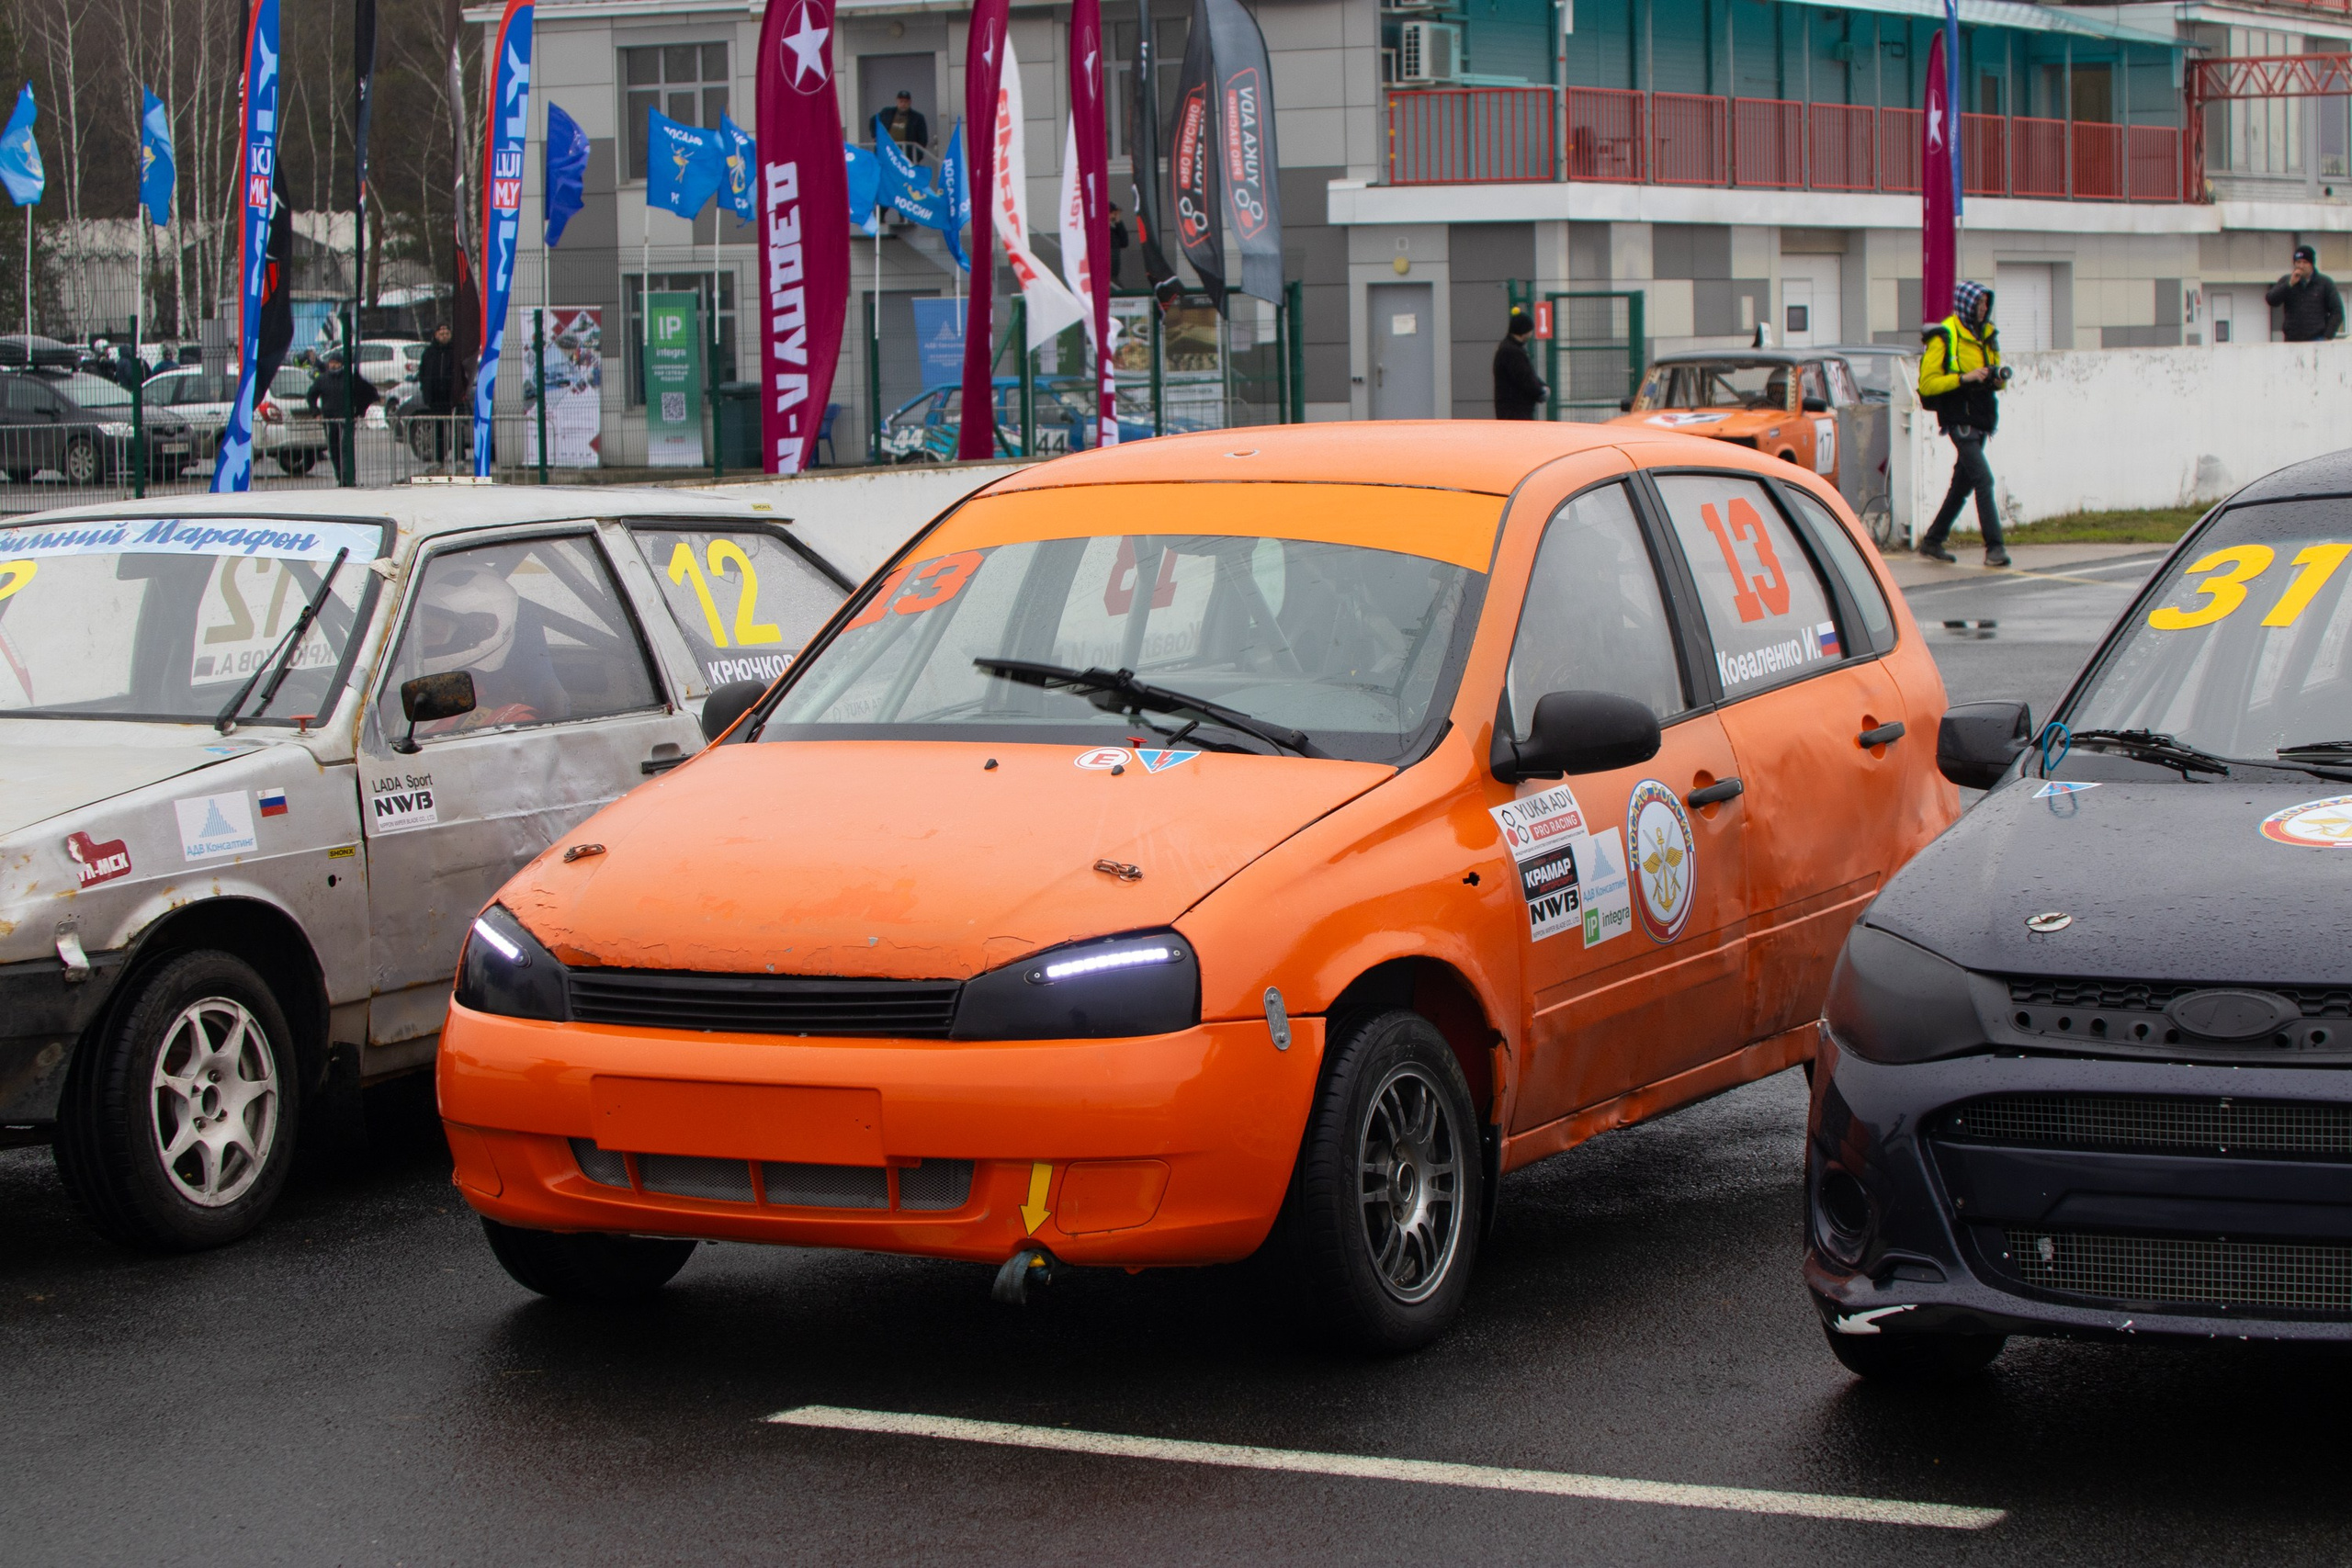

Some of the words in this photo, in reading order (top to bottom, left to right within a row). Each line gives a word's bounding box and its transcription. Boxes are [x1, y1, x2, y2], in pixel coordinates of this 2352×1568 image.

[658, 315, 682, 340] IP
[1539, 308, 1548, 334] 1
[1818, 432, 1833, 461] 17
[132, 519, 320, 555] Марафон
[1701, 497, 1790, 623] 13
[667, 538, 783, 648] 12
[840, 550, 985, 635] 13
[2147, 543, 2352, 631] 31
[1715, 637, 1803, 687] Коваленко
[1801, 626, 1823, 661] И.
[1089, 753, 1120, 765] E
[372, 776, 403, 793] LADA
[405, 773, 434, 790] Sport
[373, 790, 434, 818] NWB
[1513, 797, 1553, 820] YUKA
[1548, 788, 1574, 811] ADV
[1533, 825, 1551, 838] PRO
[1550, 814, 1578, 831] RACING
[1629, 785, 1649, 865] ДОСААФ
[1651, 784, 1693, 847] РОССИИ
[187, 843, 205, 857] АДВ
[206, 838, 254, 853] Консалтинг
[329, 848, 355, 857] SHONX
[1525, 857, 1572, 888] КРАМАР
[1583, 887, 1596, 902] АДВ
[1596, 877, 1627, 897] Консалтинг
[1530, 889, 1579, 925] NWB
[1587, 915, 1598, 938] IP
[1602, 906, 1630, 928] integra
